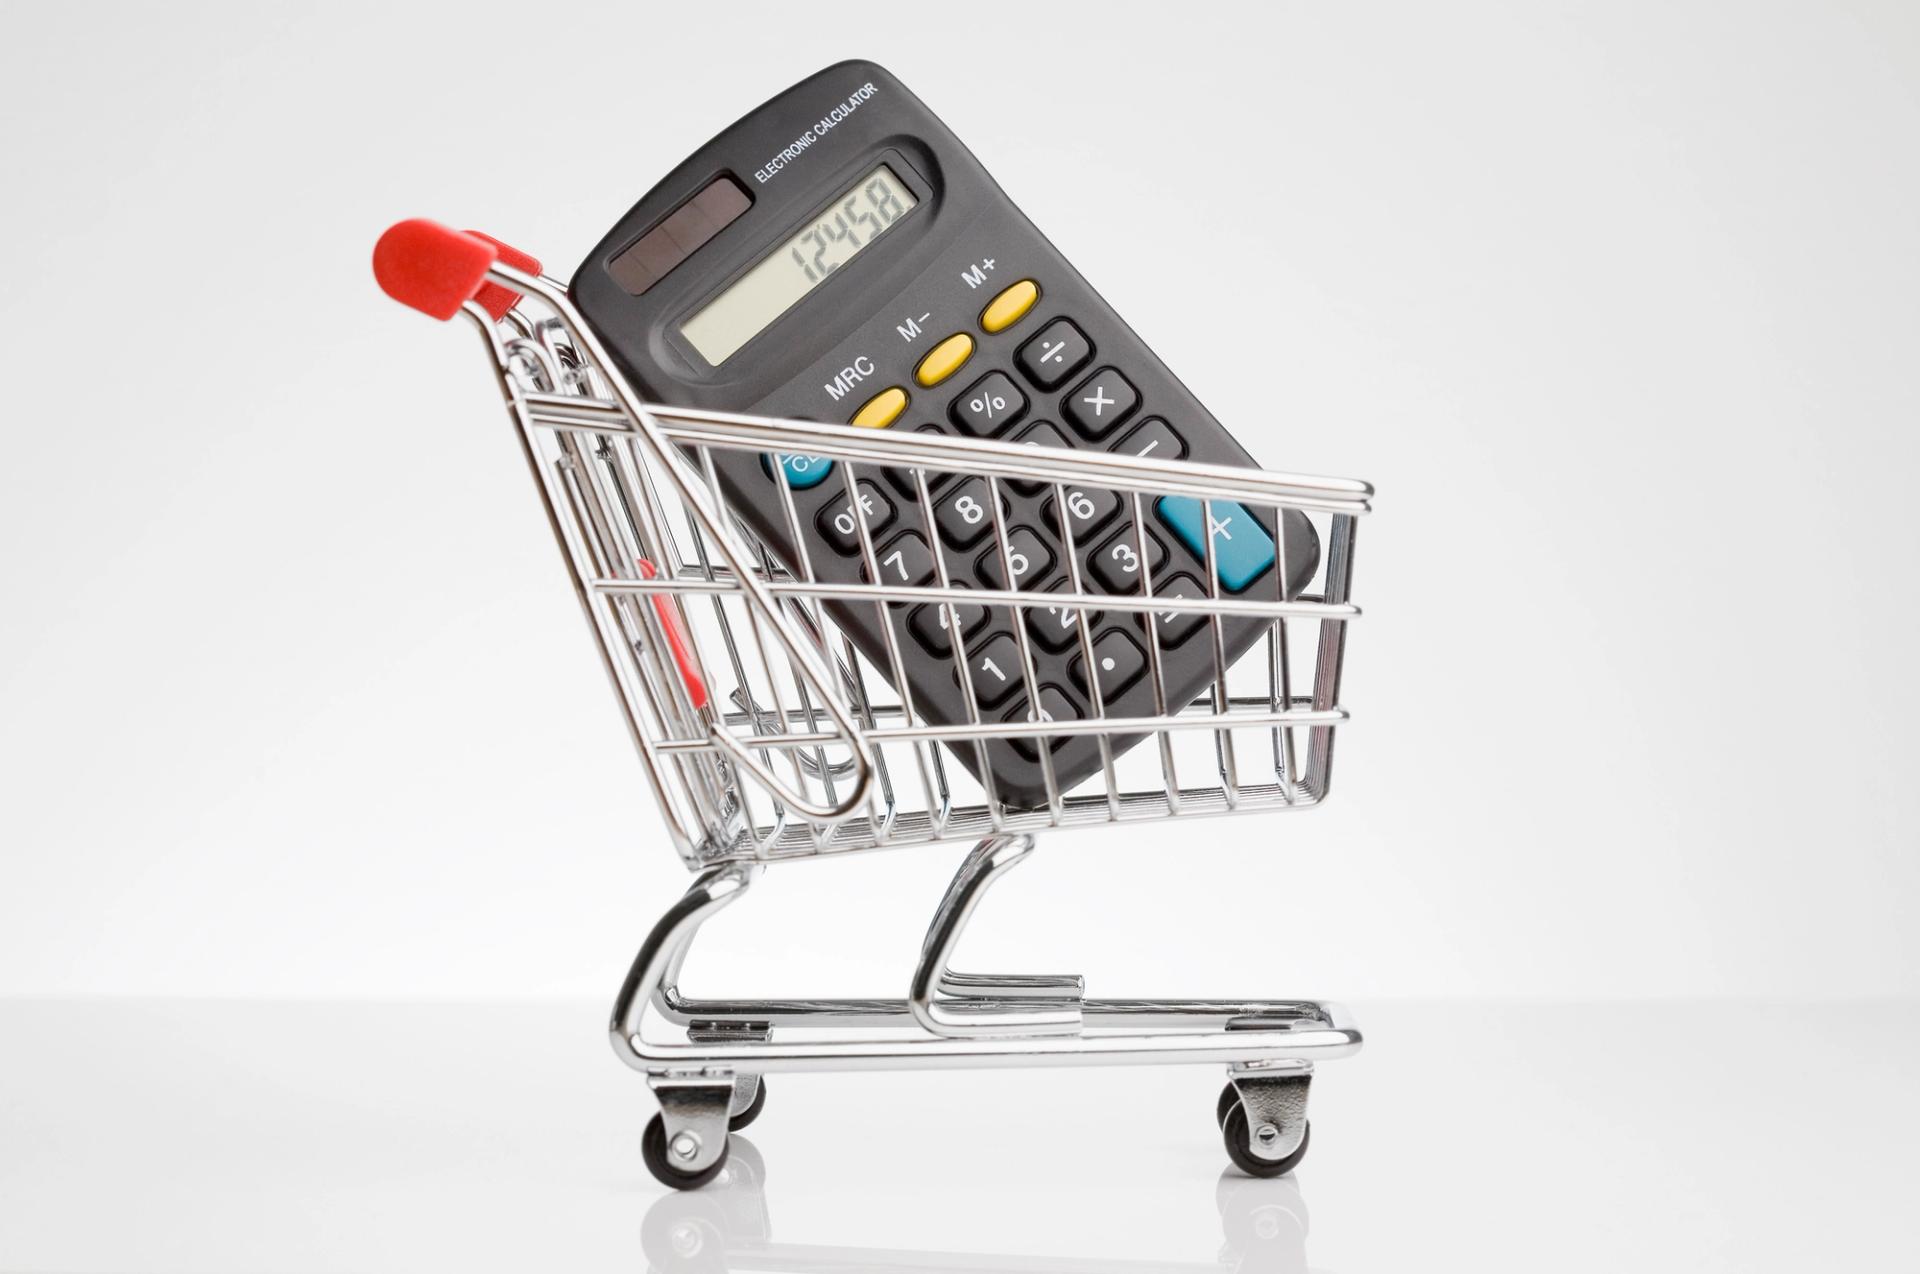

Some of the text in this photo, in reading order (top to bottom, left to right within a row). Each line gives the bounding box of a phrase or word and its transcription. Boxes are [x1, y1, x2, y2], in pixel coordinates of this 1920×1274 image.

[754, 82, 878, 183] ELECTRONIC CALCULATOR
[960, 258, 996, 289] M+
[824, 356, 875, 401] MRC
[954, 495, 984, 525] 8
[1067, 491, 1096, 521] 6
[883, 550, 910, 582] 7
[1111, 543, 1140, 573] 3
[981, 656, 1007, 682] 1
